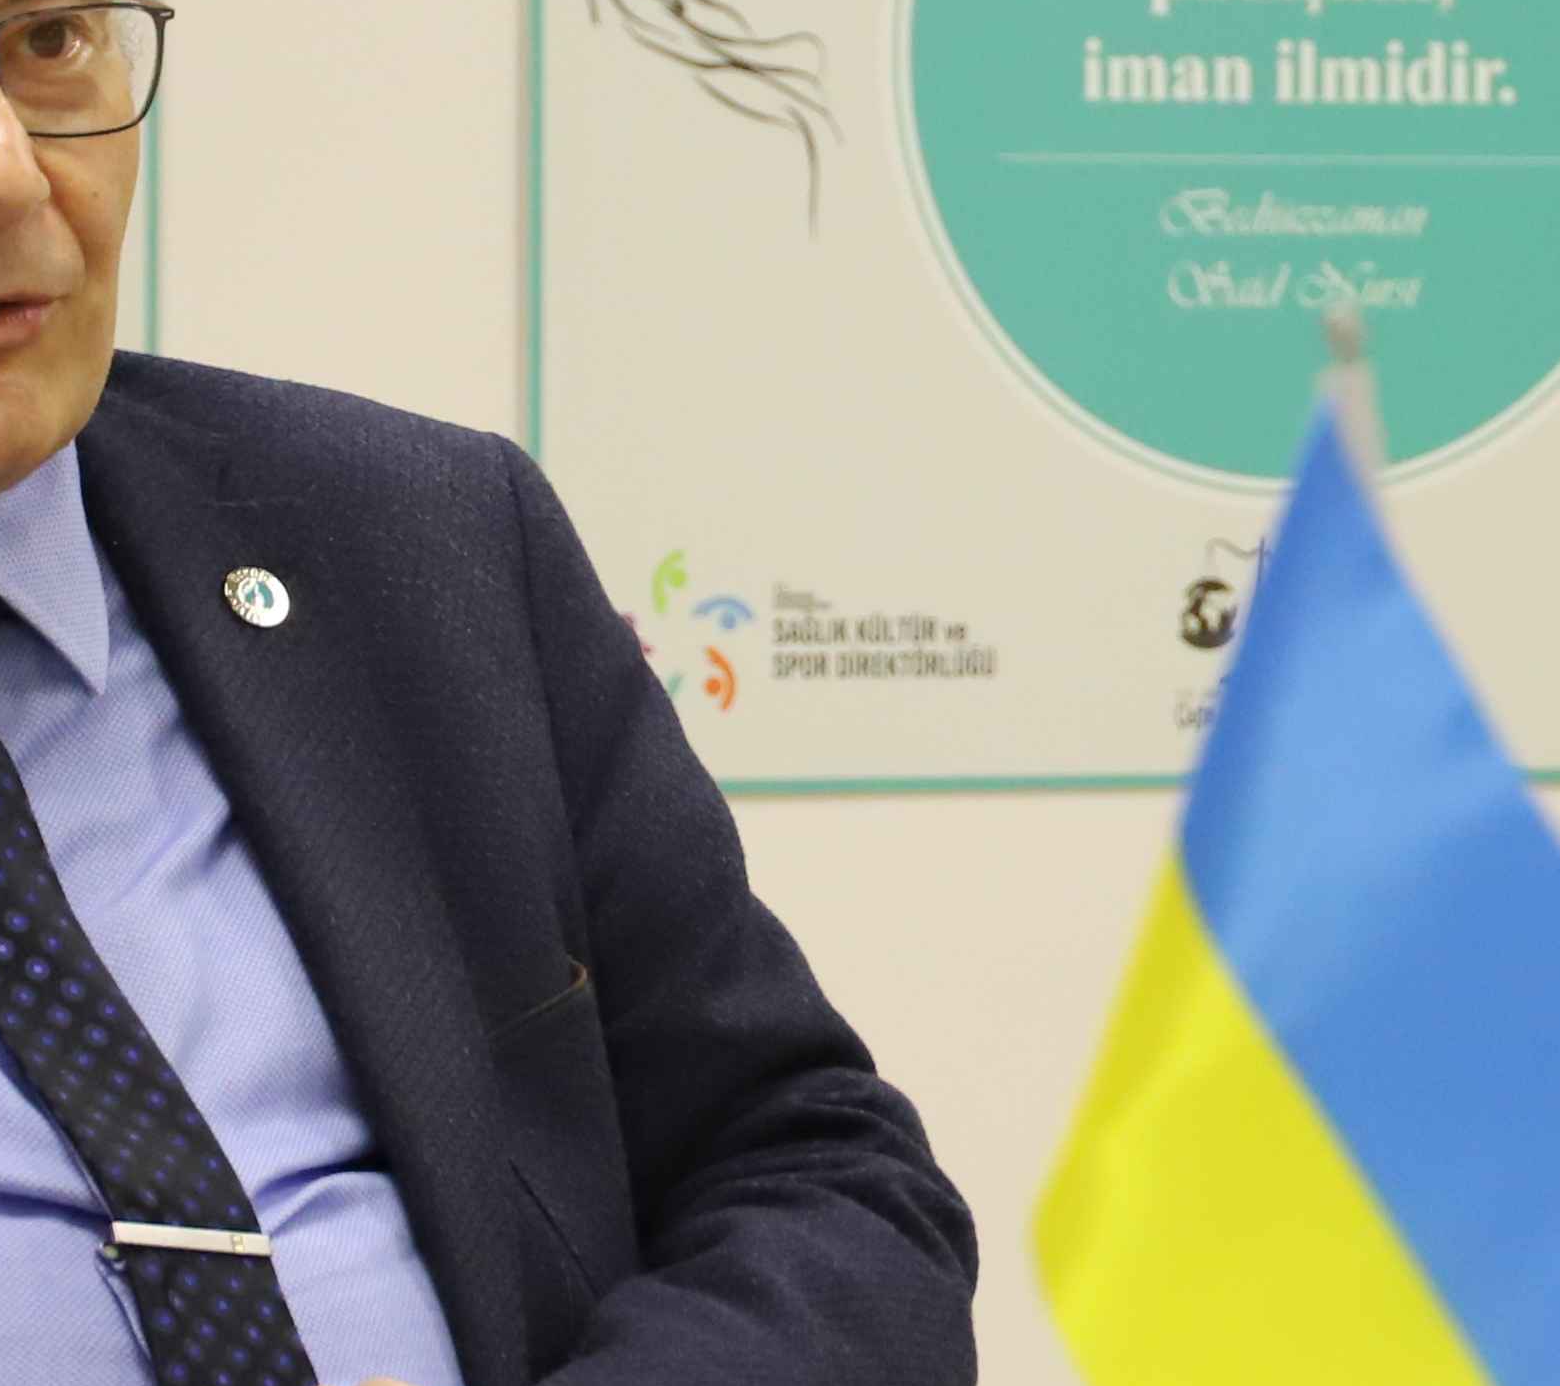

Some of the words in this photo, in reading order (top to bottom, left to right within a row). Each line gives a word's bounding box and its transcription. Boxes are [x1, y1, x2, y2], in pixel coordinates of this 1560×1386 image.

[1082, 36, 1253, 104] iman
[1274, 39, 1518, 107] ilmidir.
[772, 651, 828, 680] SPOR
